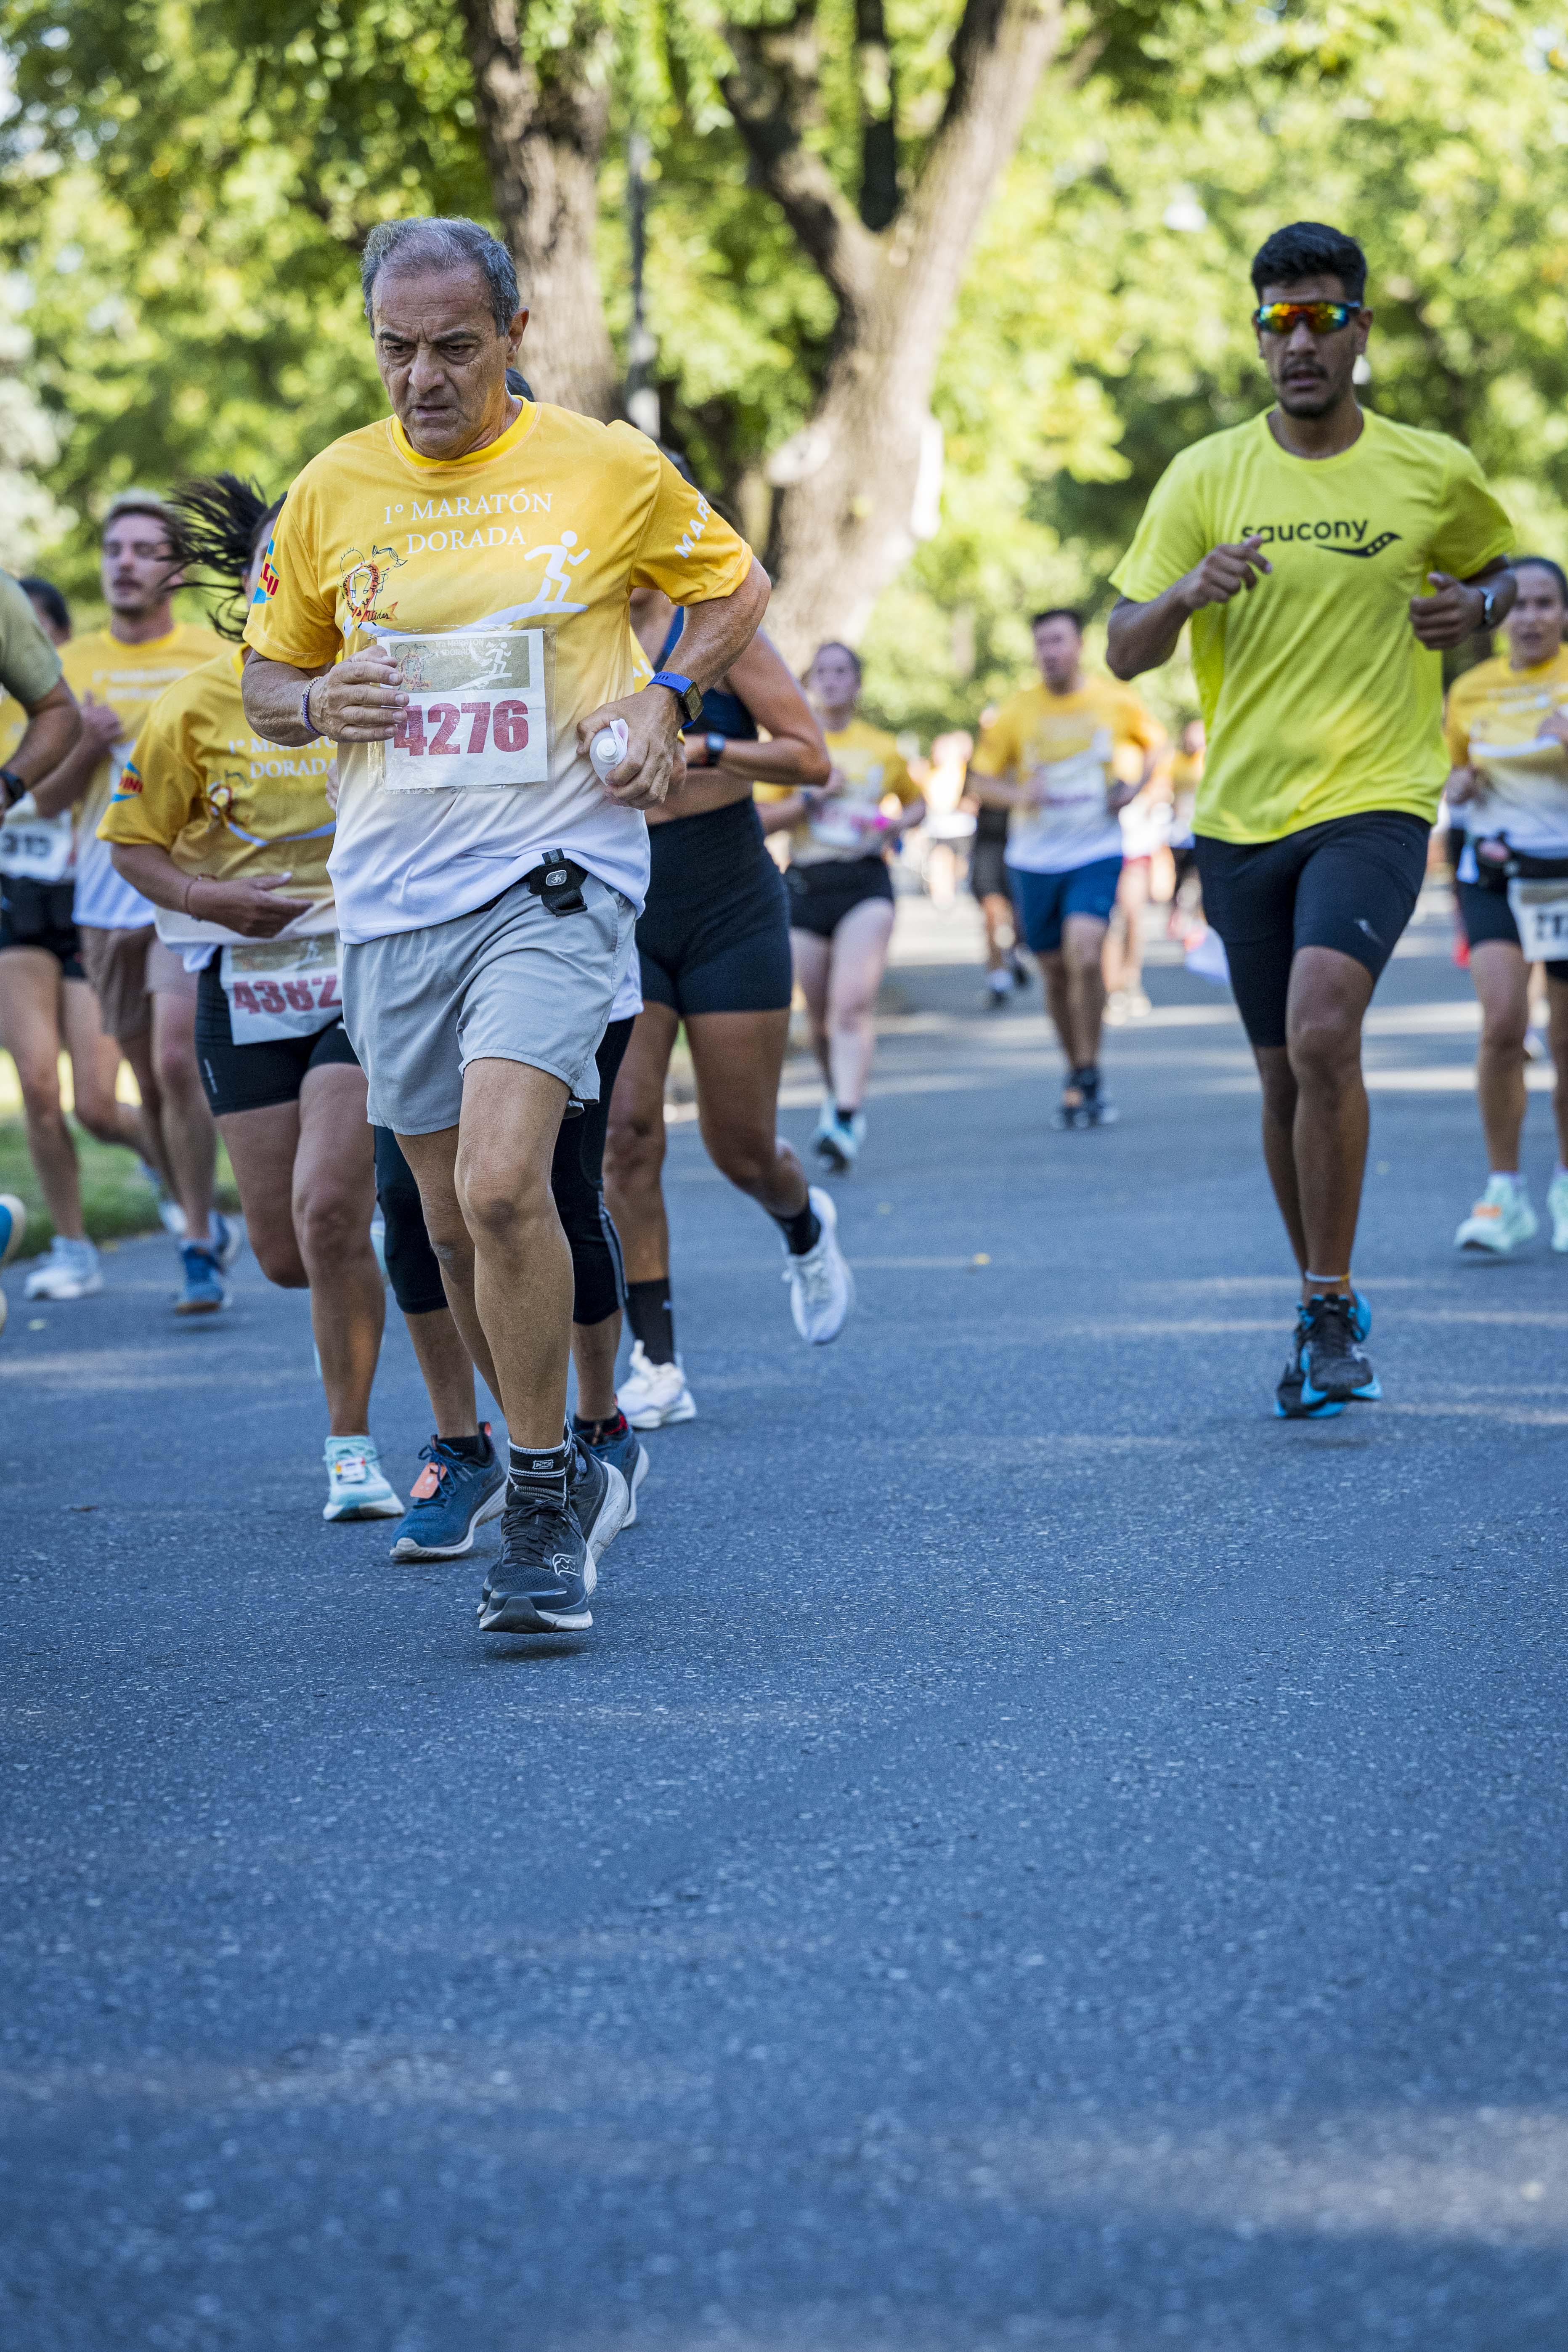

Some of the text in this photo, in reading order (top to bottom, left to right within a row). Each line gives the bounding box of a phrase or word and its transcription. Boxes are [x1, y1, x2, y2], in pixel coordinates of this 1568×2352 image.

[411, 488, 553, 520] MARATÓN
[406, 526, 527, 554] DORADA
[1242, 519, 1368, 543] saucony
[394, 700, 529, 756] 4276
